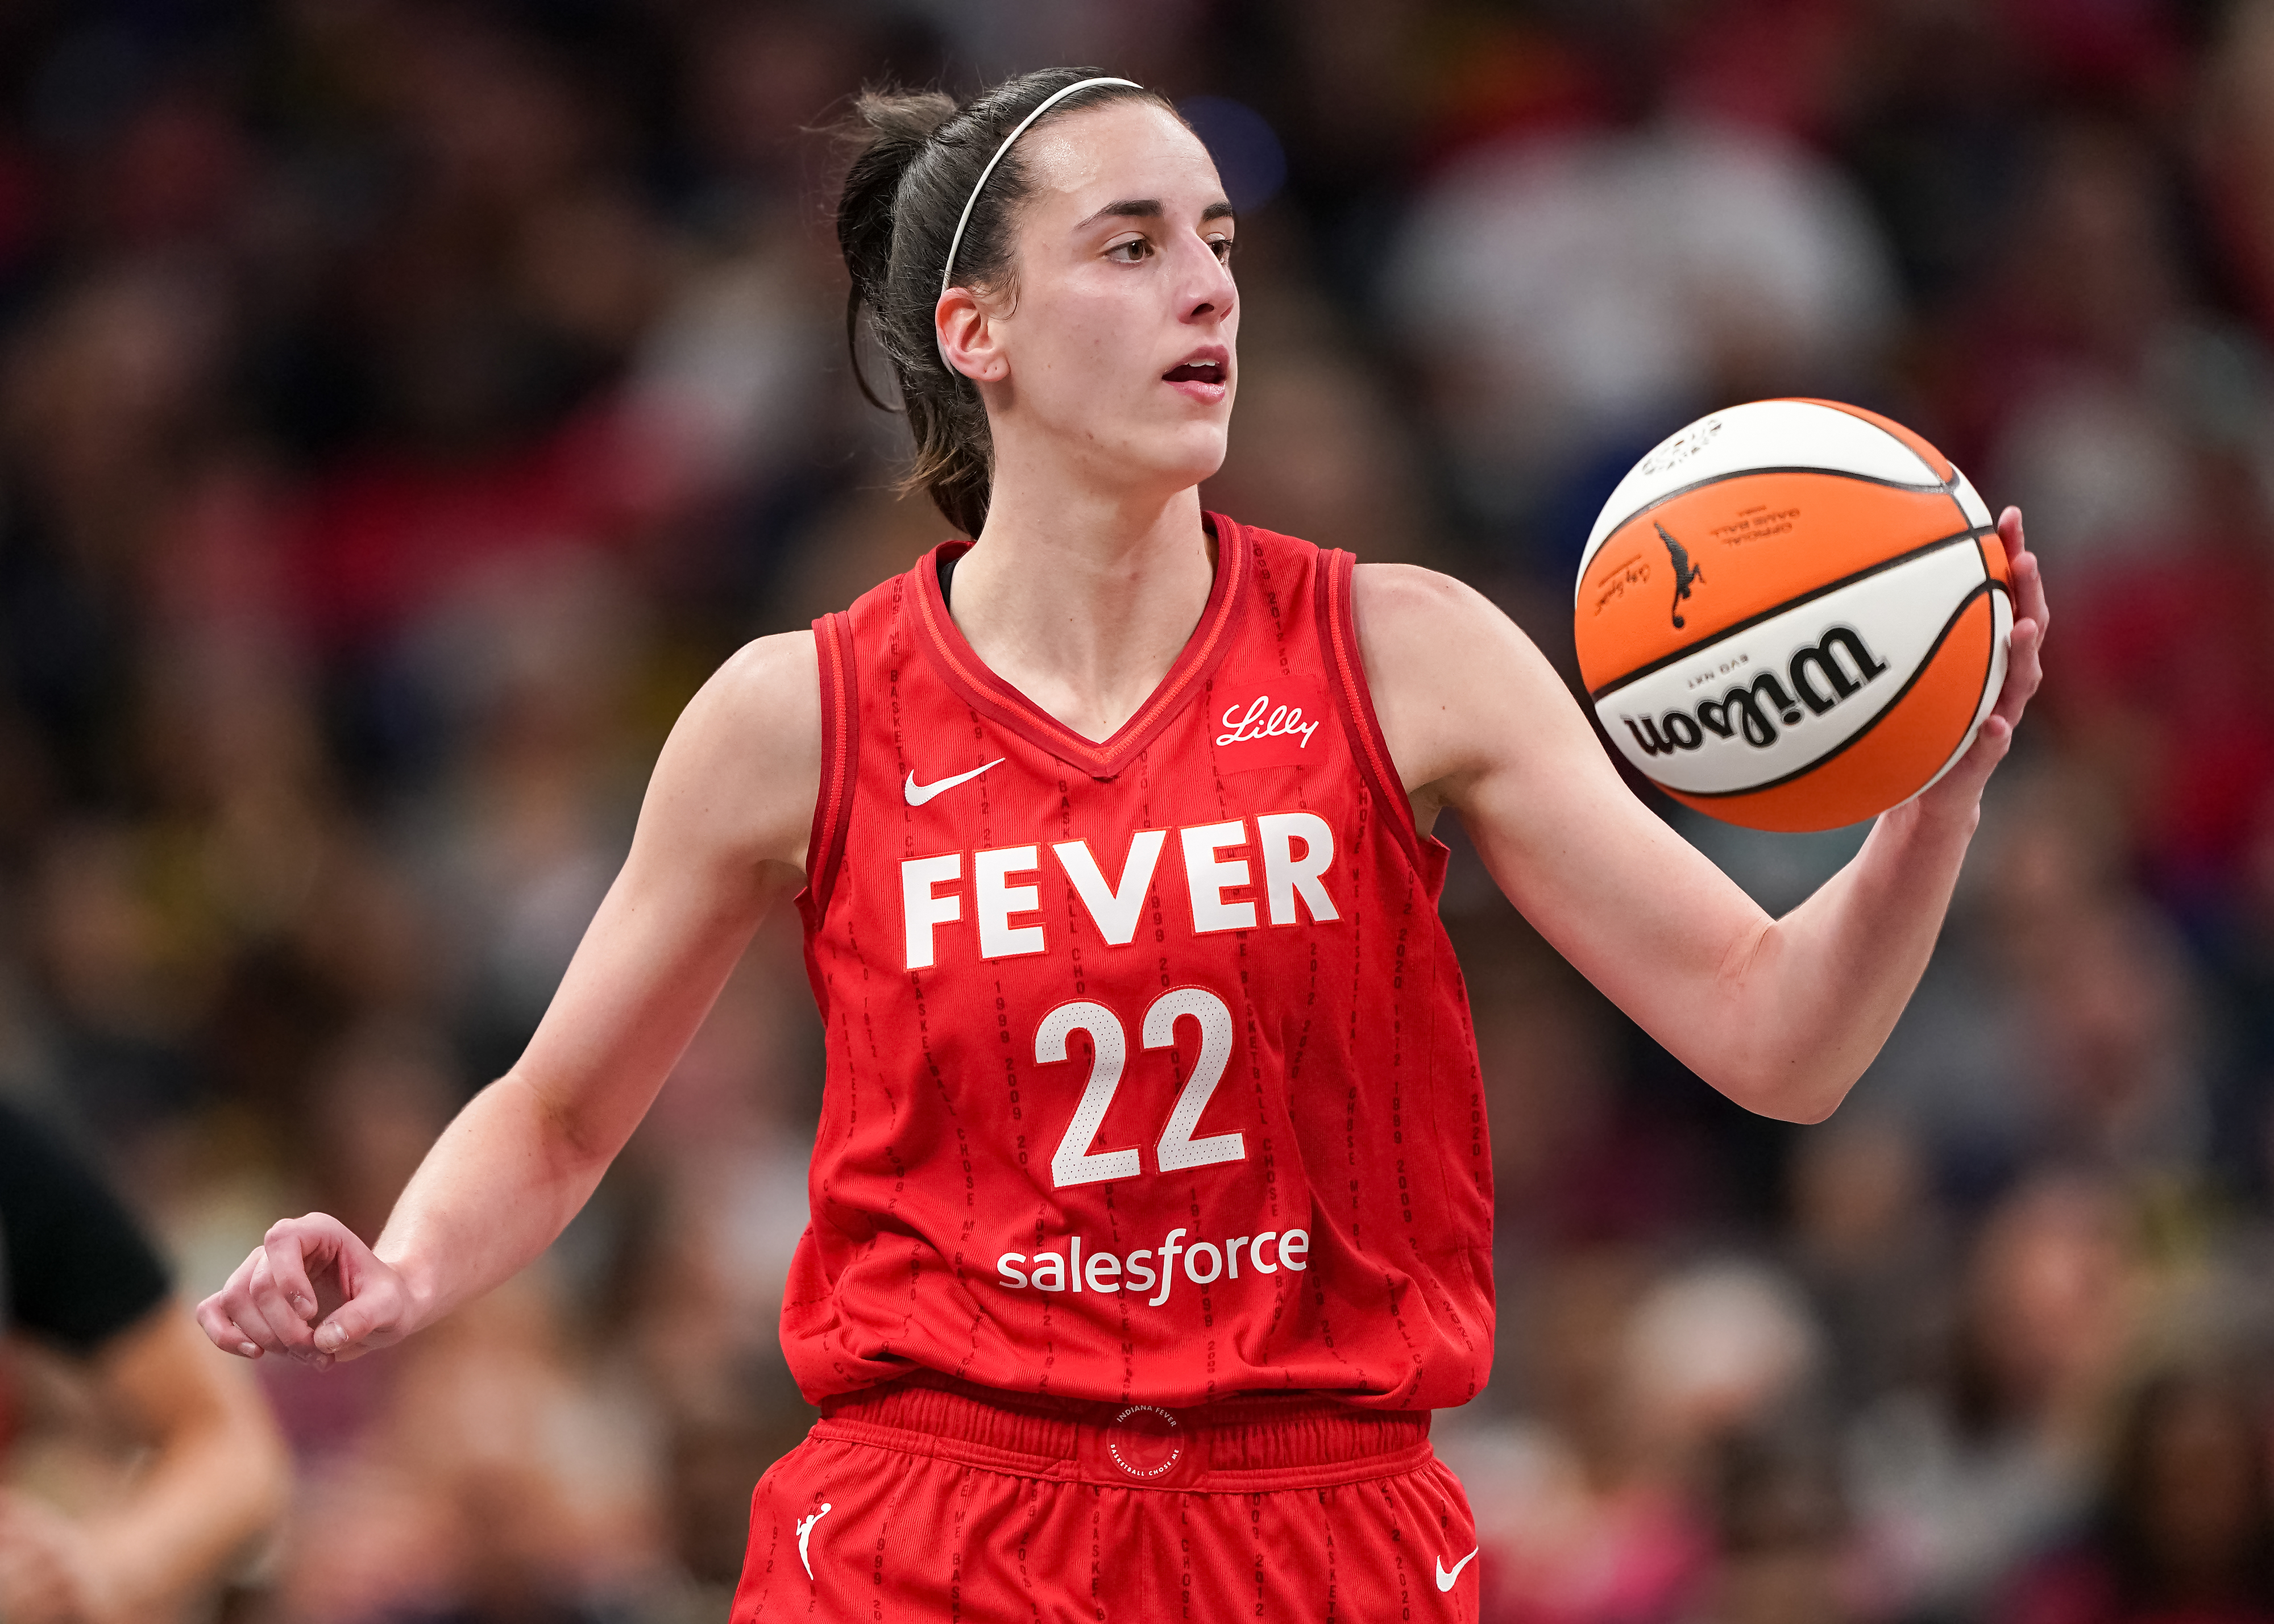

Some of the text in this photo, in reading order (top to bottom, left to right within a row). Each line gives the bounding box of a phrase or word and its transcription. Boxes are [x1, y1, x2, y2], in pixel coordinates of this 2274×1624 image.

[1624, 626, 1887, 757] Wilson
[1686, 654, 1749, 691] EVO NXT
[1215, 695, 1319, 749] Lilly
[901, 812, 1341, 970] FEVER
[1404, 871, 1414, 915] 012
[1072, 947, 1085, 994] CHO
[1159, 957, 1170, 987] 20
[1394, 928, 1408, 989] 2020
[995, 981, 1010, 1044] 1999
[1005, 1057, 1022, 1120] 2009
[911, 971, 957, 1116] BASKETBALL
[957, 1128, 974, 1206] CHOSE
[1033, 986, 1247, 1190] 22
[1471, 1094, 1480, 1157] 2020
[1349, 912, 1360, 1071] BASKETBAL
[1400, 1353, 1422, 1409] CHOS
[1396, 1159, 1412, 1223] 2009
[997, 1228, 1309, 1307] salesforce
[1309, 1259, 1325, 1306] 009
[1116, 1405, 1177, 1427] INDIANA FEVER
[1110, 1444, 1180, 1476] BASKETBALL CHOSE ME
[1181, 1539, 1190, 1619] CHOSE
[1255, 1554, 1263, 1617] 2012
[1395, 1556, 1410, 1621] 2020
